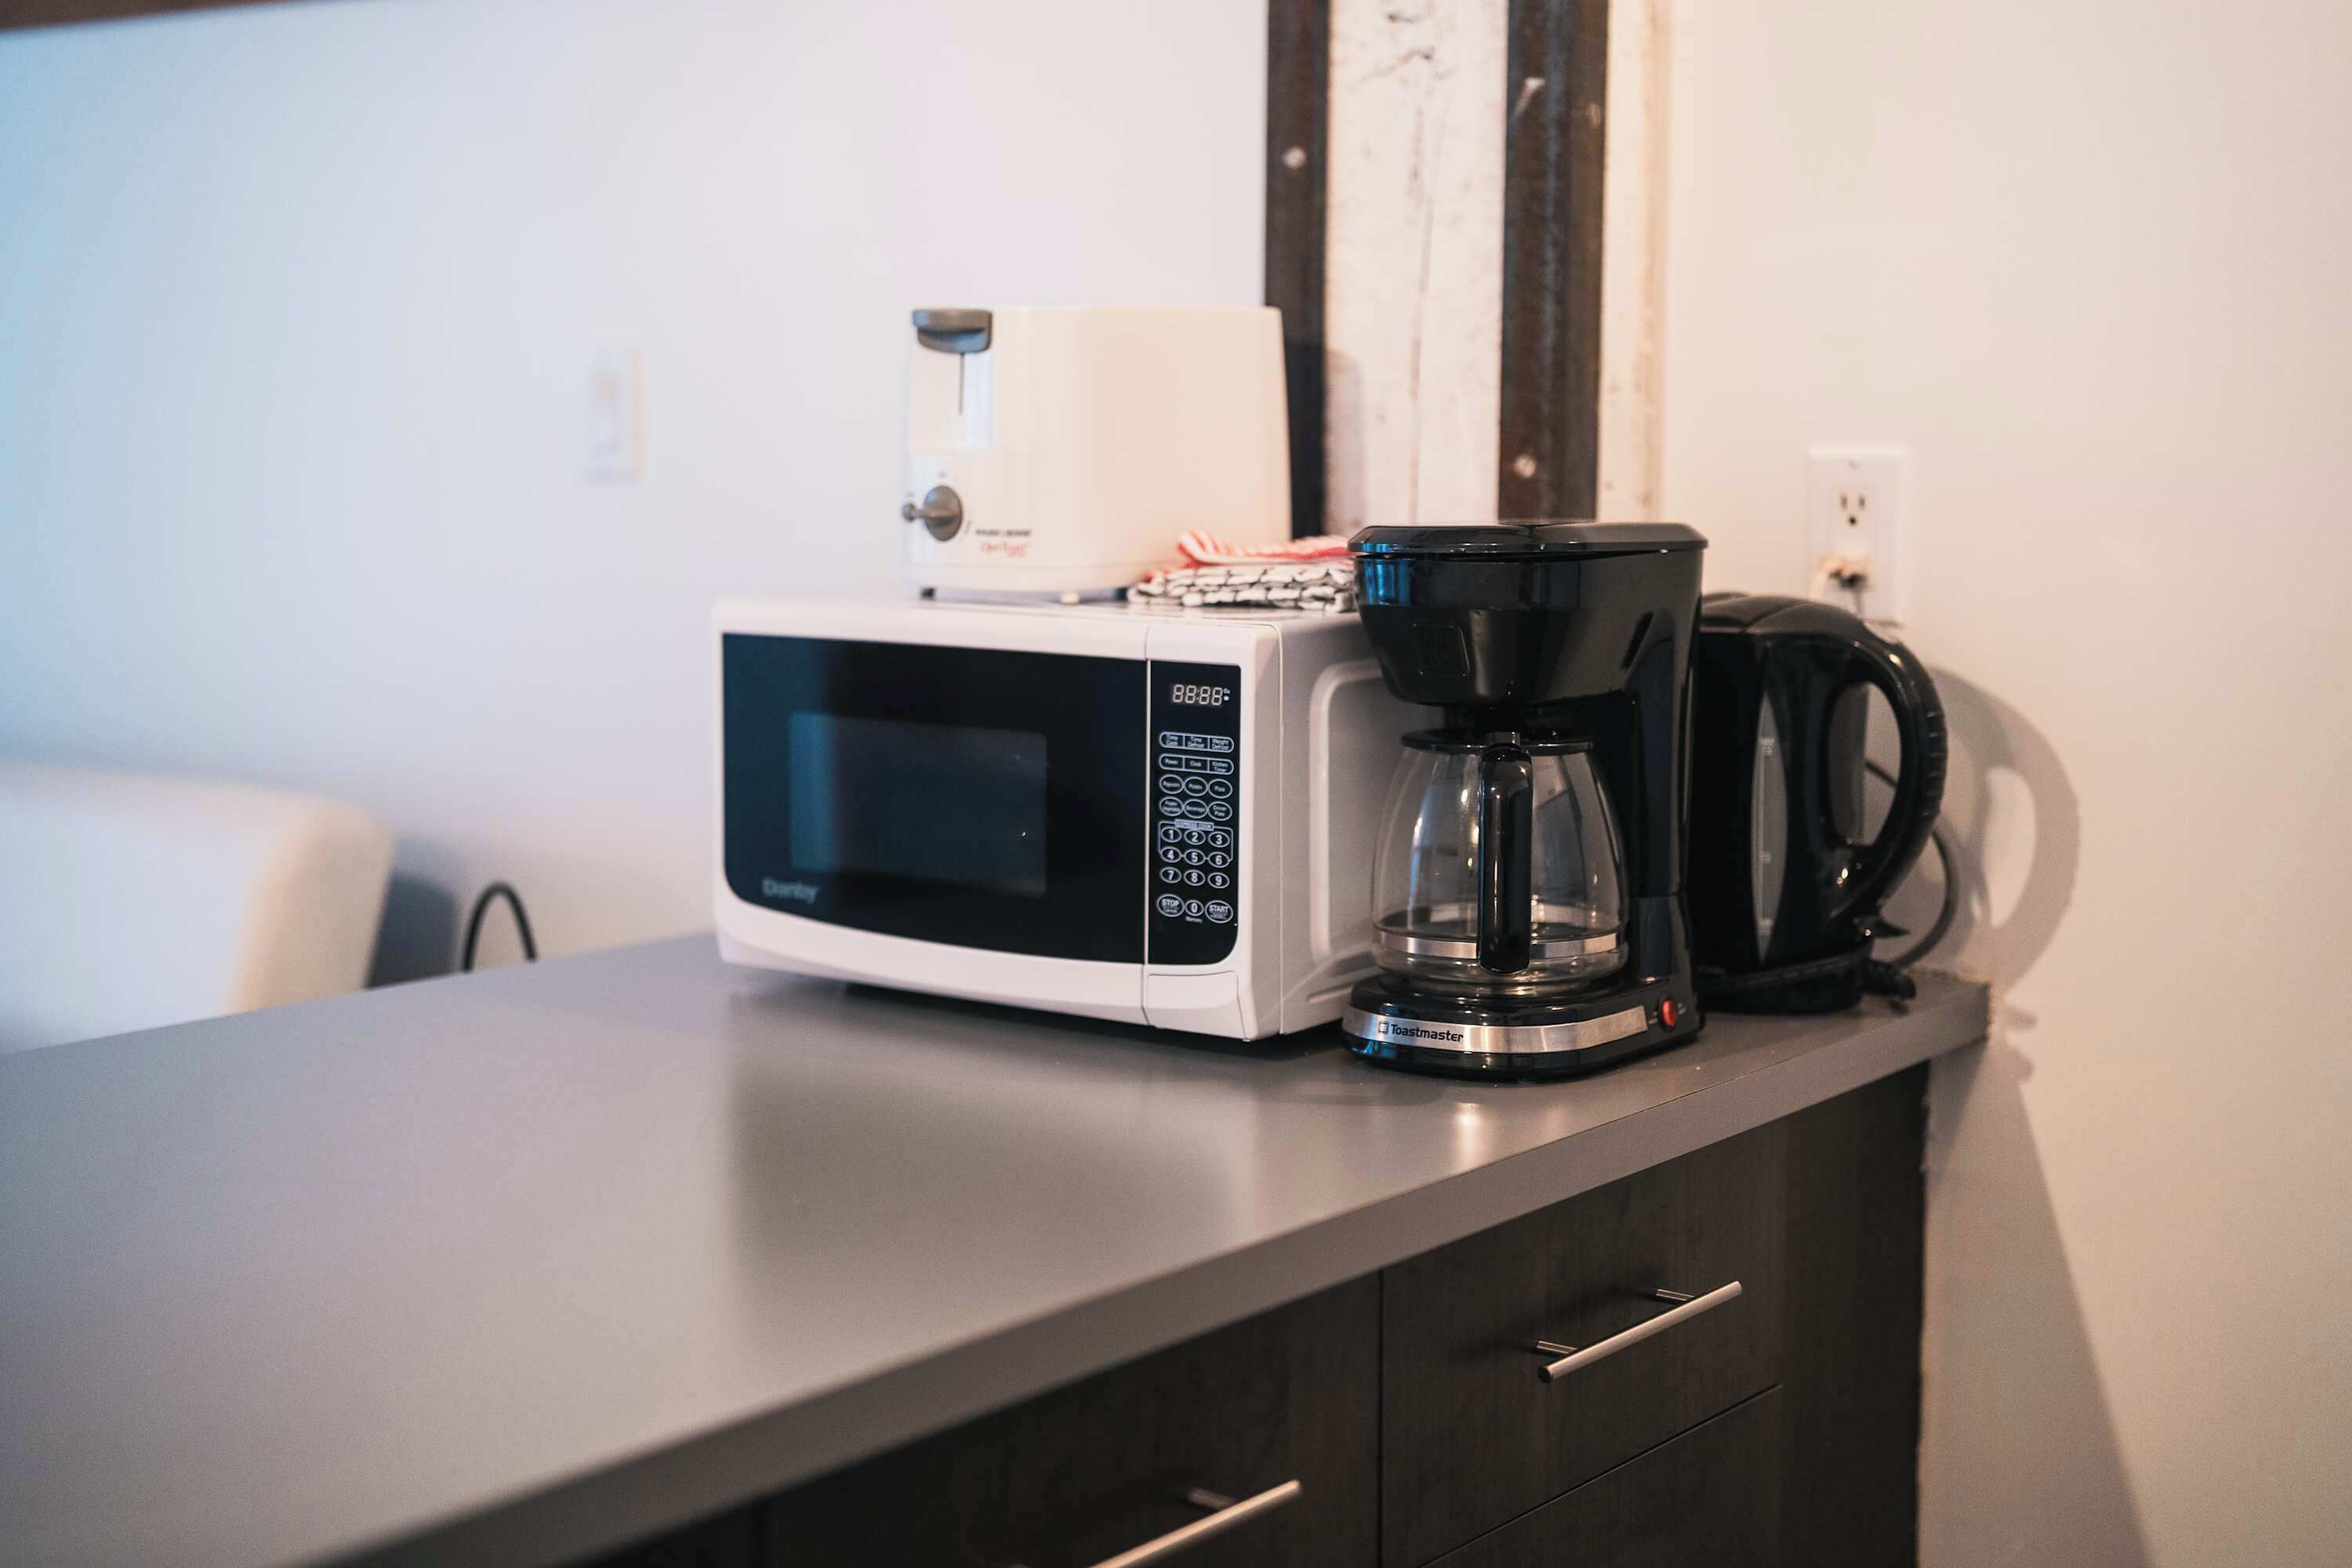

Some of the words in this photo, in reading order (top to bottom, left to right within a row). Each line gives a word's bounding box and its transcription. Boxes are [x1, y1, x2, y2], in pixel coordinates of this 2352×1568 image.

[1168, 829, 1174, 840] 1
[1192, 832, 1199, 842] 2
[1216, 834, 1222, 844] 3
[1167, 850, 1174, 860] 4
[1192, 852, 1198, 862] 5
[1216, 855, 1222, 865] 6
[1167, 870, 1174, 880] 7
[1191, 872, 1198, 883] 8
[1216, 876, 1222, 886] 9
[762, 877, 818, 904] Danby
[1162, 898, 1180, 907] STOP
[1191, 902, 1198, 913] 0
[1391, 1024, 1464, 1042] Toastmaster
